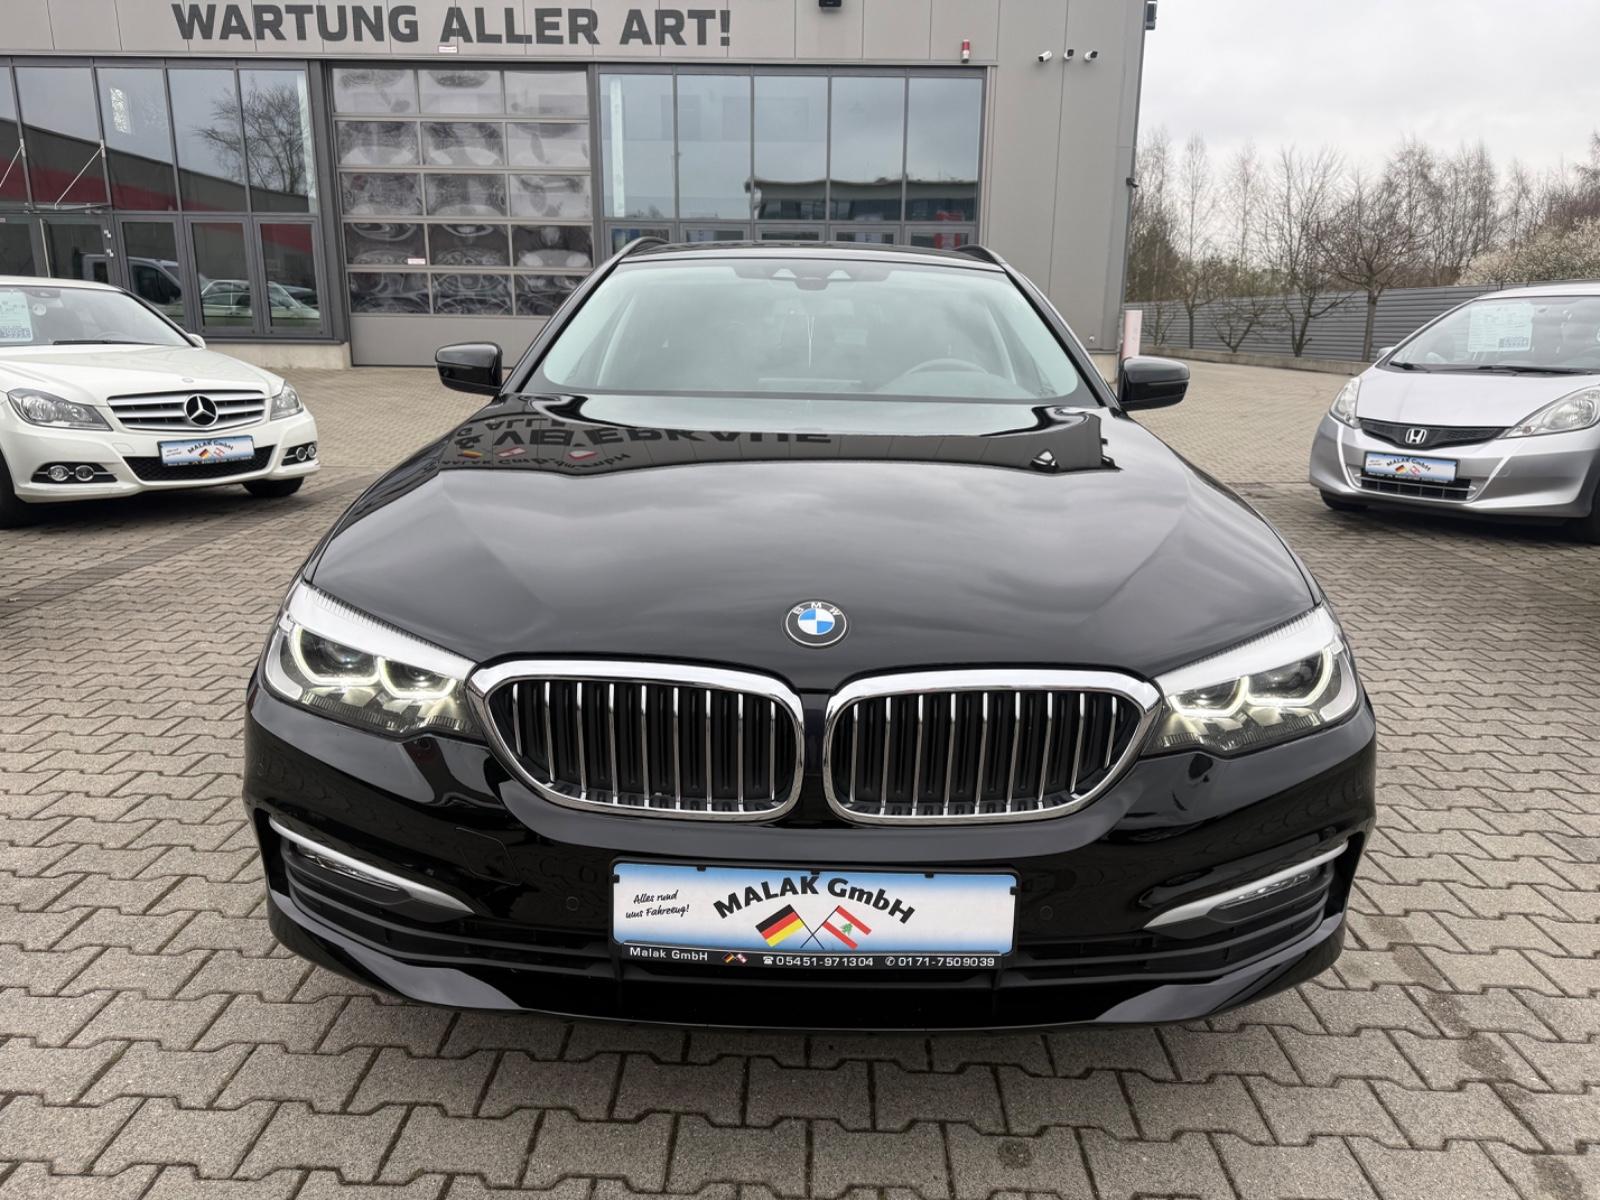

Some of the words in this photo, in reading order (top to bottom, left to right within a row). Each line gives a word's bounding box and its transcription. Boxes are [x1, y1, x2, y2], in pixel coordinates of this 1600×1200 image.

[171, 4, 419, 43] WARTUNG
[439, 6, 600, 45] ALLER
[619, 8, 731, 47] ART!
[792, 602, 841, 616] BMW
[633, 893, 655, 904] Alles
[656, 889, 679, 901] rund
[713, 876, 819, 919] MALAK
[827, 877, 916, 924] GmbH
[646, 904, 690, 917] Fahrzeug!
[629, 946, 667, 959] Malak
[671, 950, 708, 961] GmbH
[776, 956, 874, 967] 05451-971304
[898, 957, 995, 967] 0171-7509039
